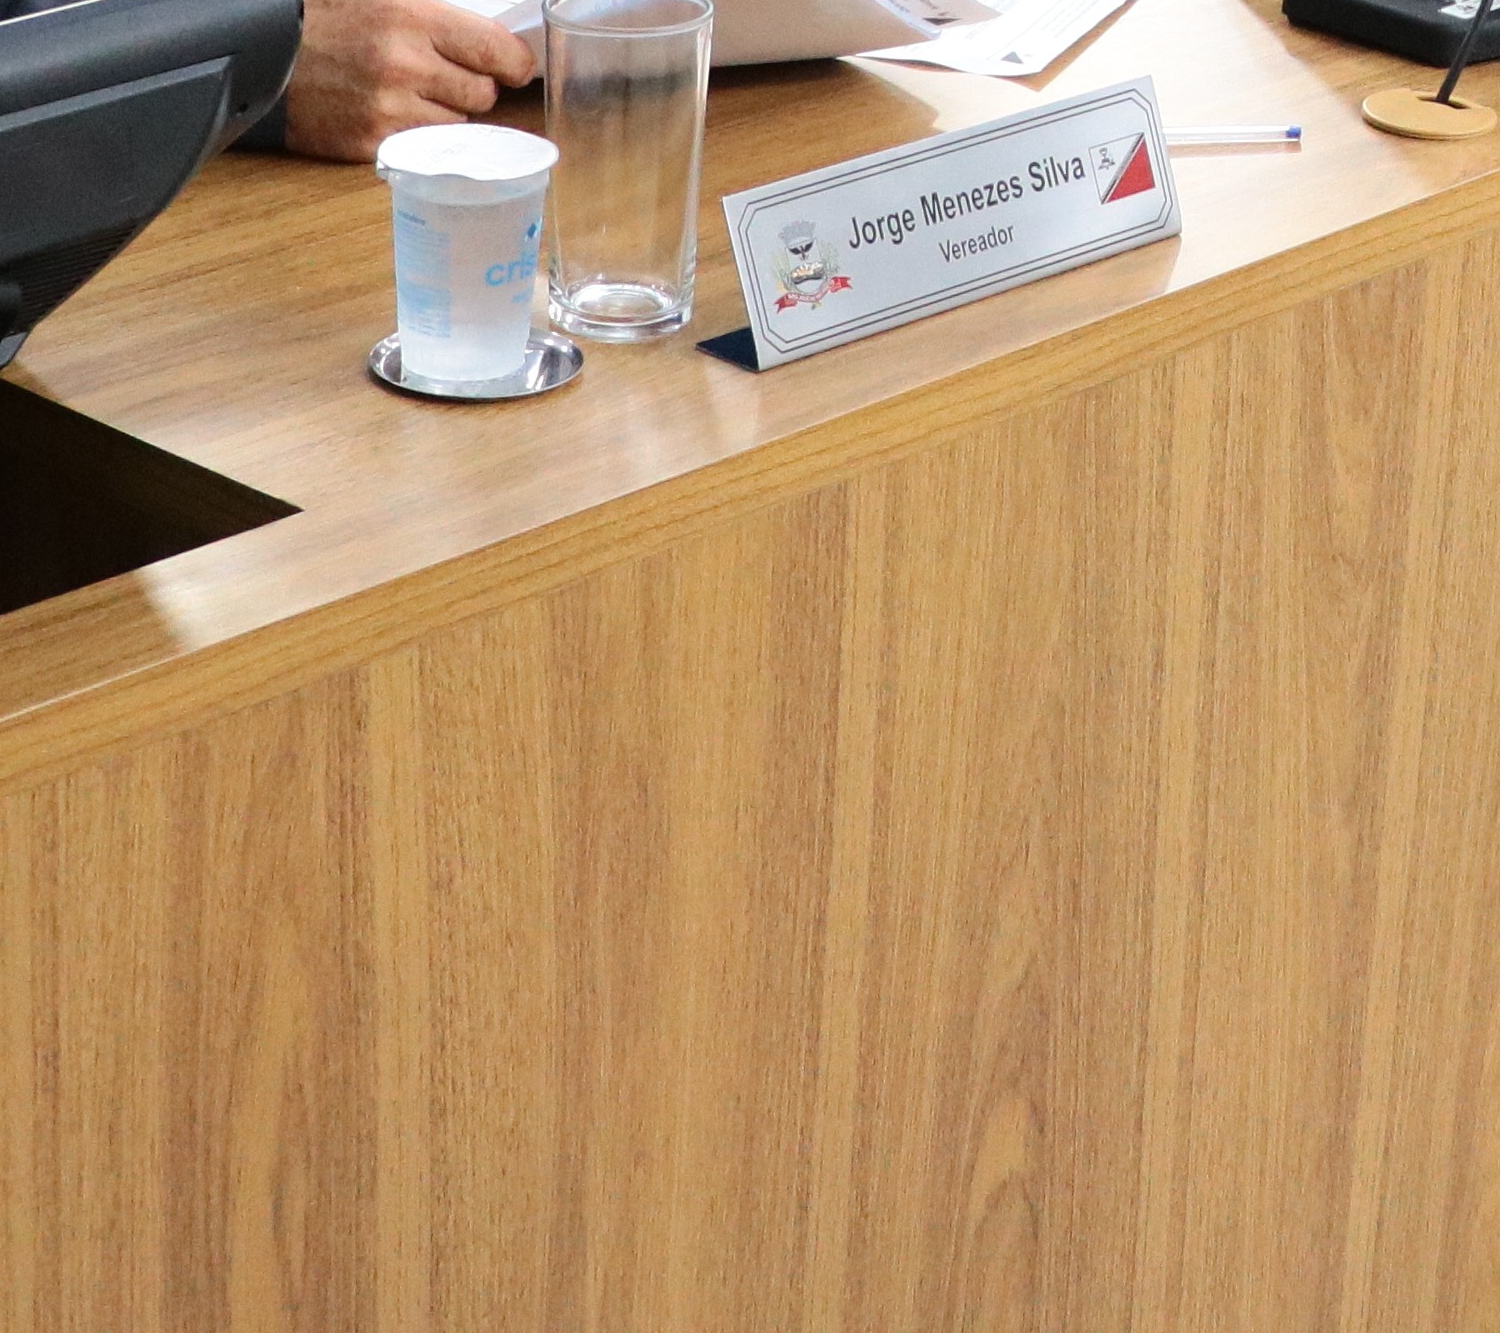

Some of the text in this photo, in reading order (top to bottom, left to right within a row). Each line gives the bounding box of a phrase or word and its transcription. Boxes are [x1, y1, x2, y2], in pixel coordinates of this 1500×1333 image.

[848, 152, 1088, 253] Jorge Menezes Silva
[938, 222, 1016, 265] Vereador
